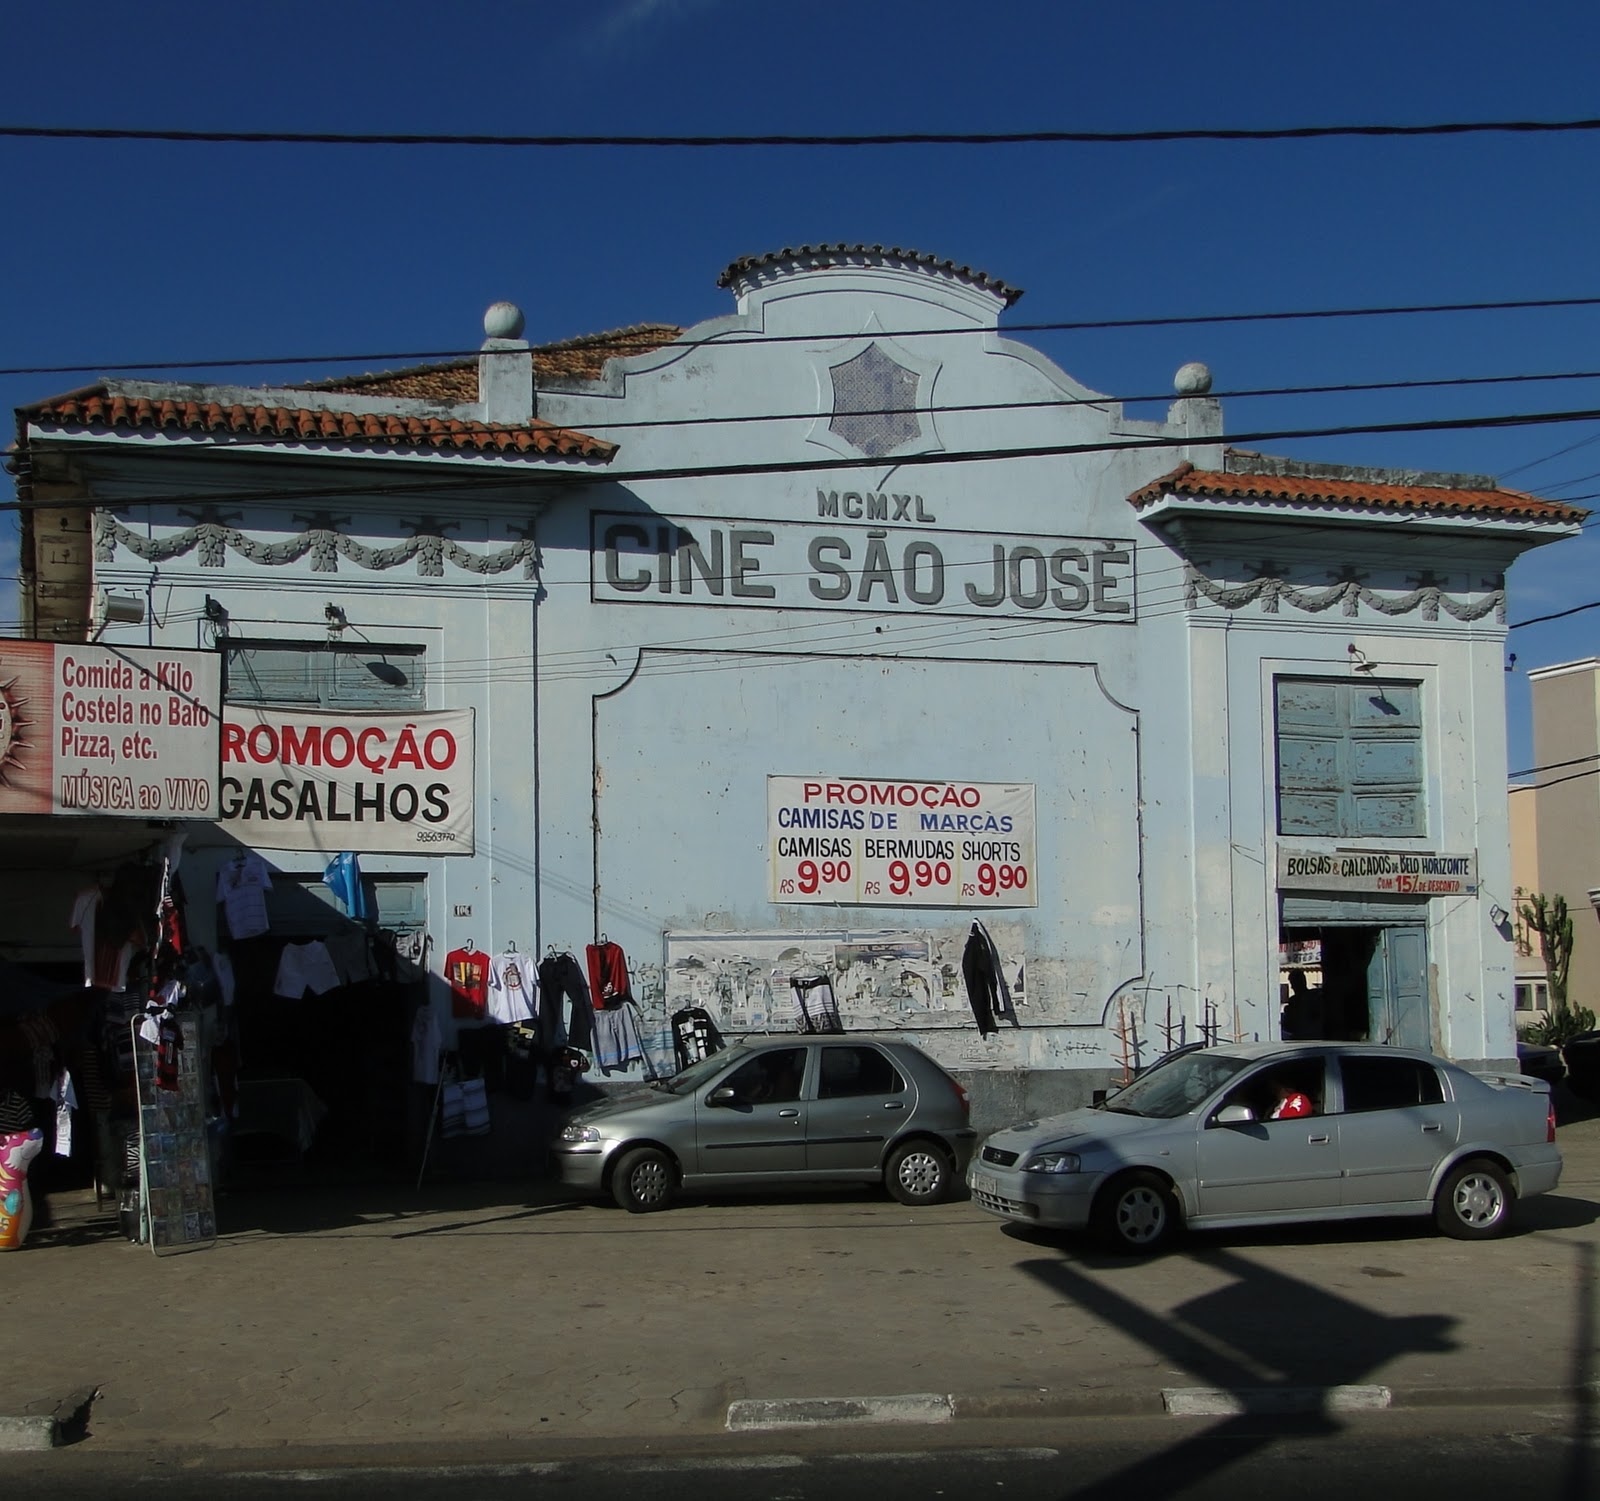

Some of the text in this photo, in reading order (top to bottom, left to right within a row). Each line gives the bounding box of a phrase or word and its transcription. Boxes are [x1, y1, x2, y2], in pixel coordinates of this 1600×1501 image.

[818, 489, 936, 523] MCMXL
[604, 523, 1130, 615] CINE SÃO JOSÉ
[62, 656, 193, 693] Comida a Kilo
[62, 691, 210, 728] Costela no Bafo
[61, 726, 158, 765] Pizza, etc.
[221, 723, 457, 775] ROMOÇÃO
[61, 768, 210, 812] MÚSICA ao VIVO
[221, 776, 450, 822] GASALHOS
[803, 782, 981, 809] PROMOÇÃO
[778, 807, 865, 830] CAMISAS
[871, 812, 898, 830] DE
[778, 837, 1021, 862] CAMISAS BERMUDAS SHORTS
[1287, 855, 1331, 876] BOLSAS
[1331, 862, 1340, 876] &
[1400, 855, 1419, 874] BELO
[1421, 857, 1469, 875] HORIZONTE
[797, 860, 852, 896] 9,90
[888, 860, 952, 897] 9,90
[977, 863, 1028, 897] 9,90
[1395, 874, 1419, 893] 15%
[1427, 880, 1460, 892] DESCONTO
